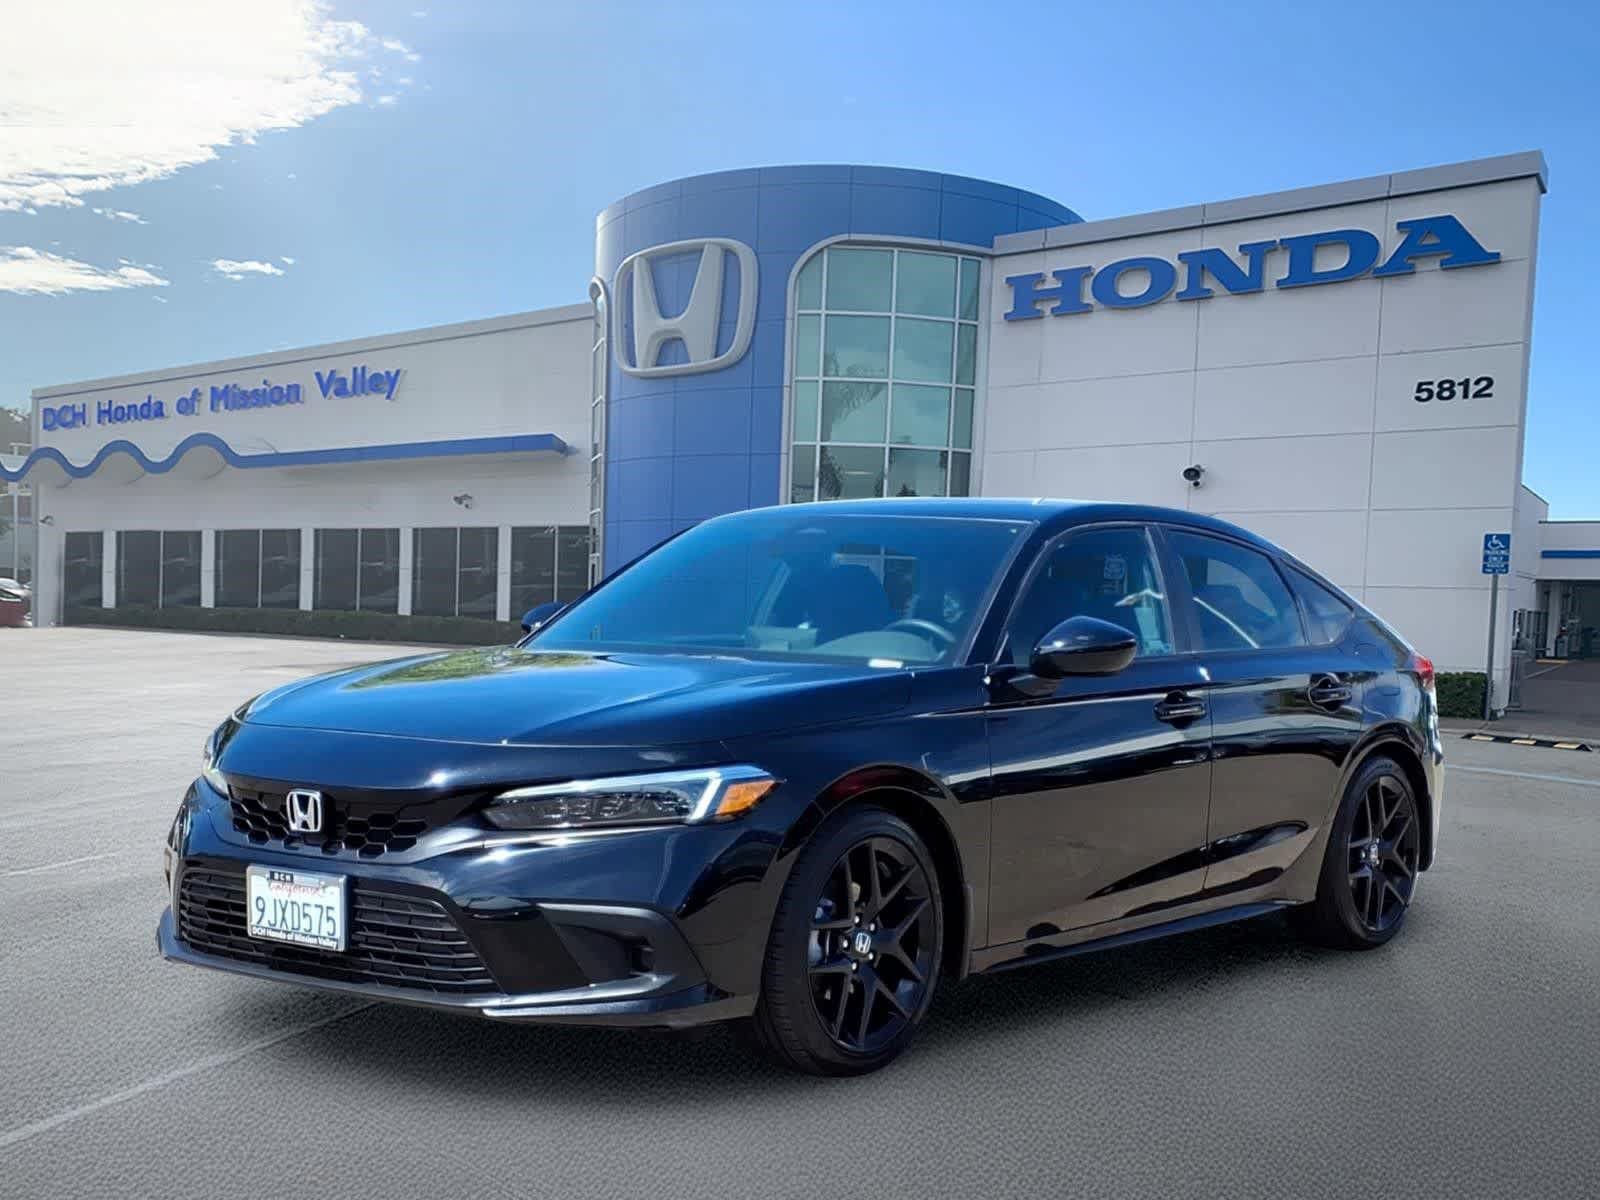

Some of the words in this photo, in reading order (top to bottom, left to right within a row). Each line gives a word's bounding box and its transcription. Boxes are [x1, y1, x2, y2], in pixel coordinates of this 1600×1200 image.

[1003, 214, 1502, 322] HONDA
[42, 403, 87, 431] DCH
[97, 394, 166, 425] Honda
[176, 388, 201, 415] of
[209, 379, 303, 412] Mission
[315, 365, 402, 400] Valley
[1414, 376, 1494, 402] 5812
[255, 896, 337, 937] 9JXD575
